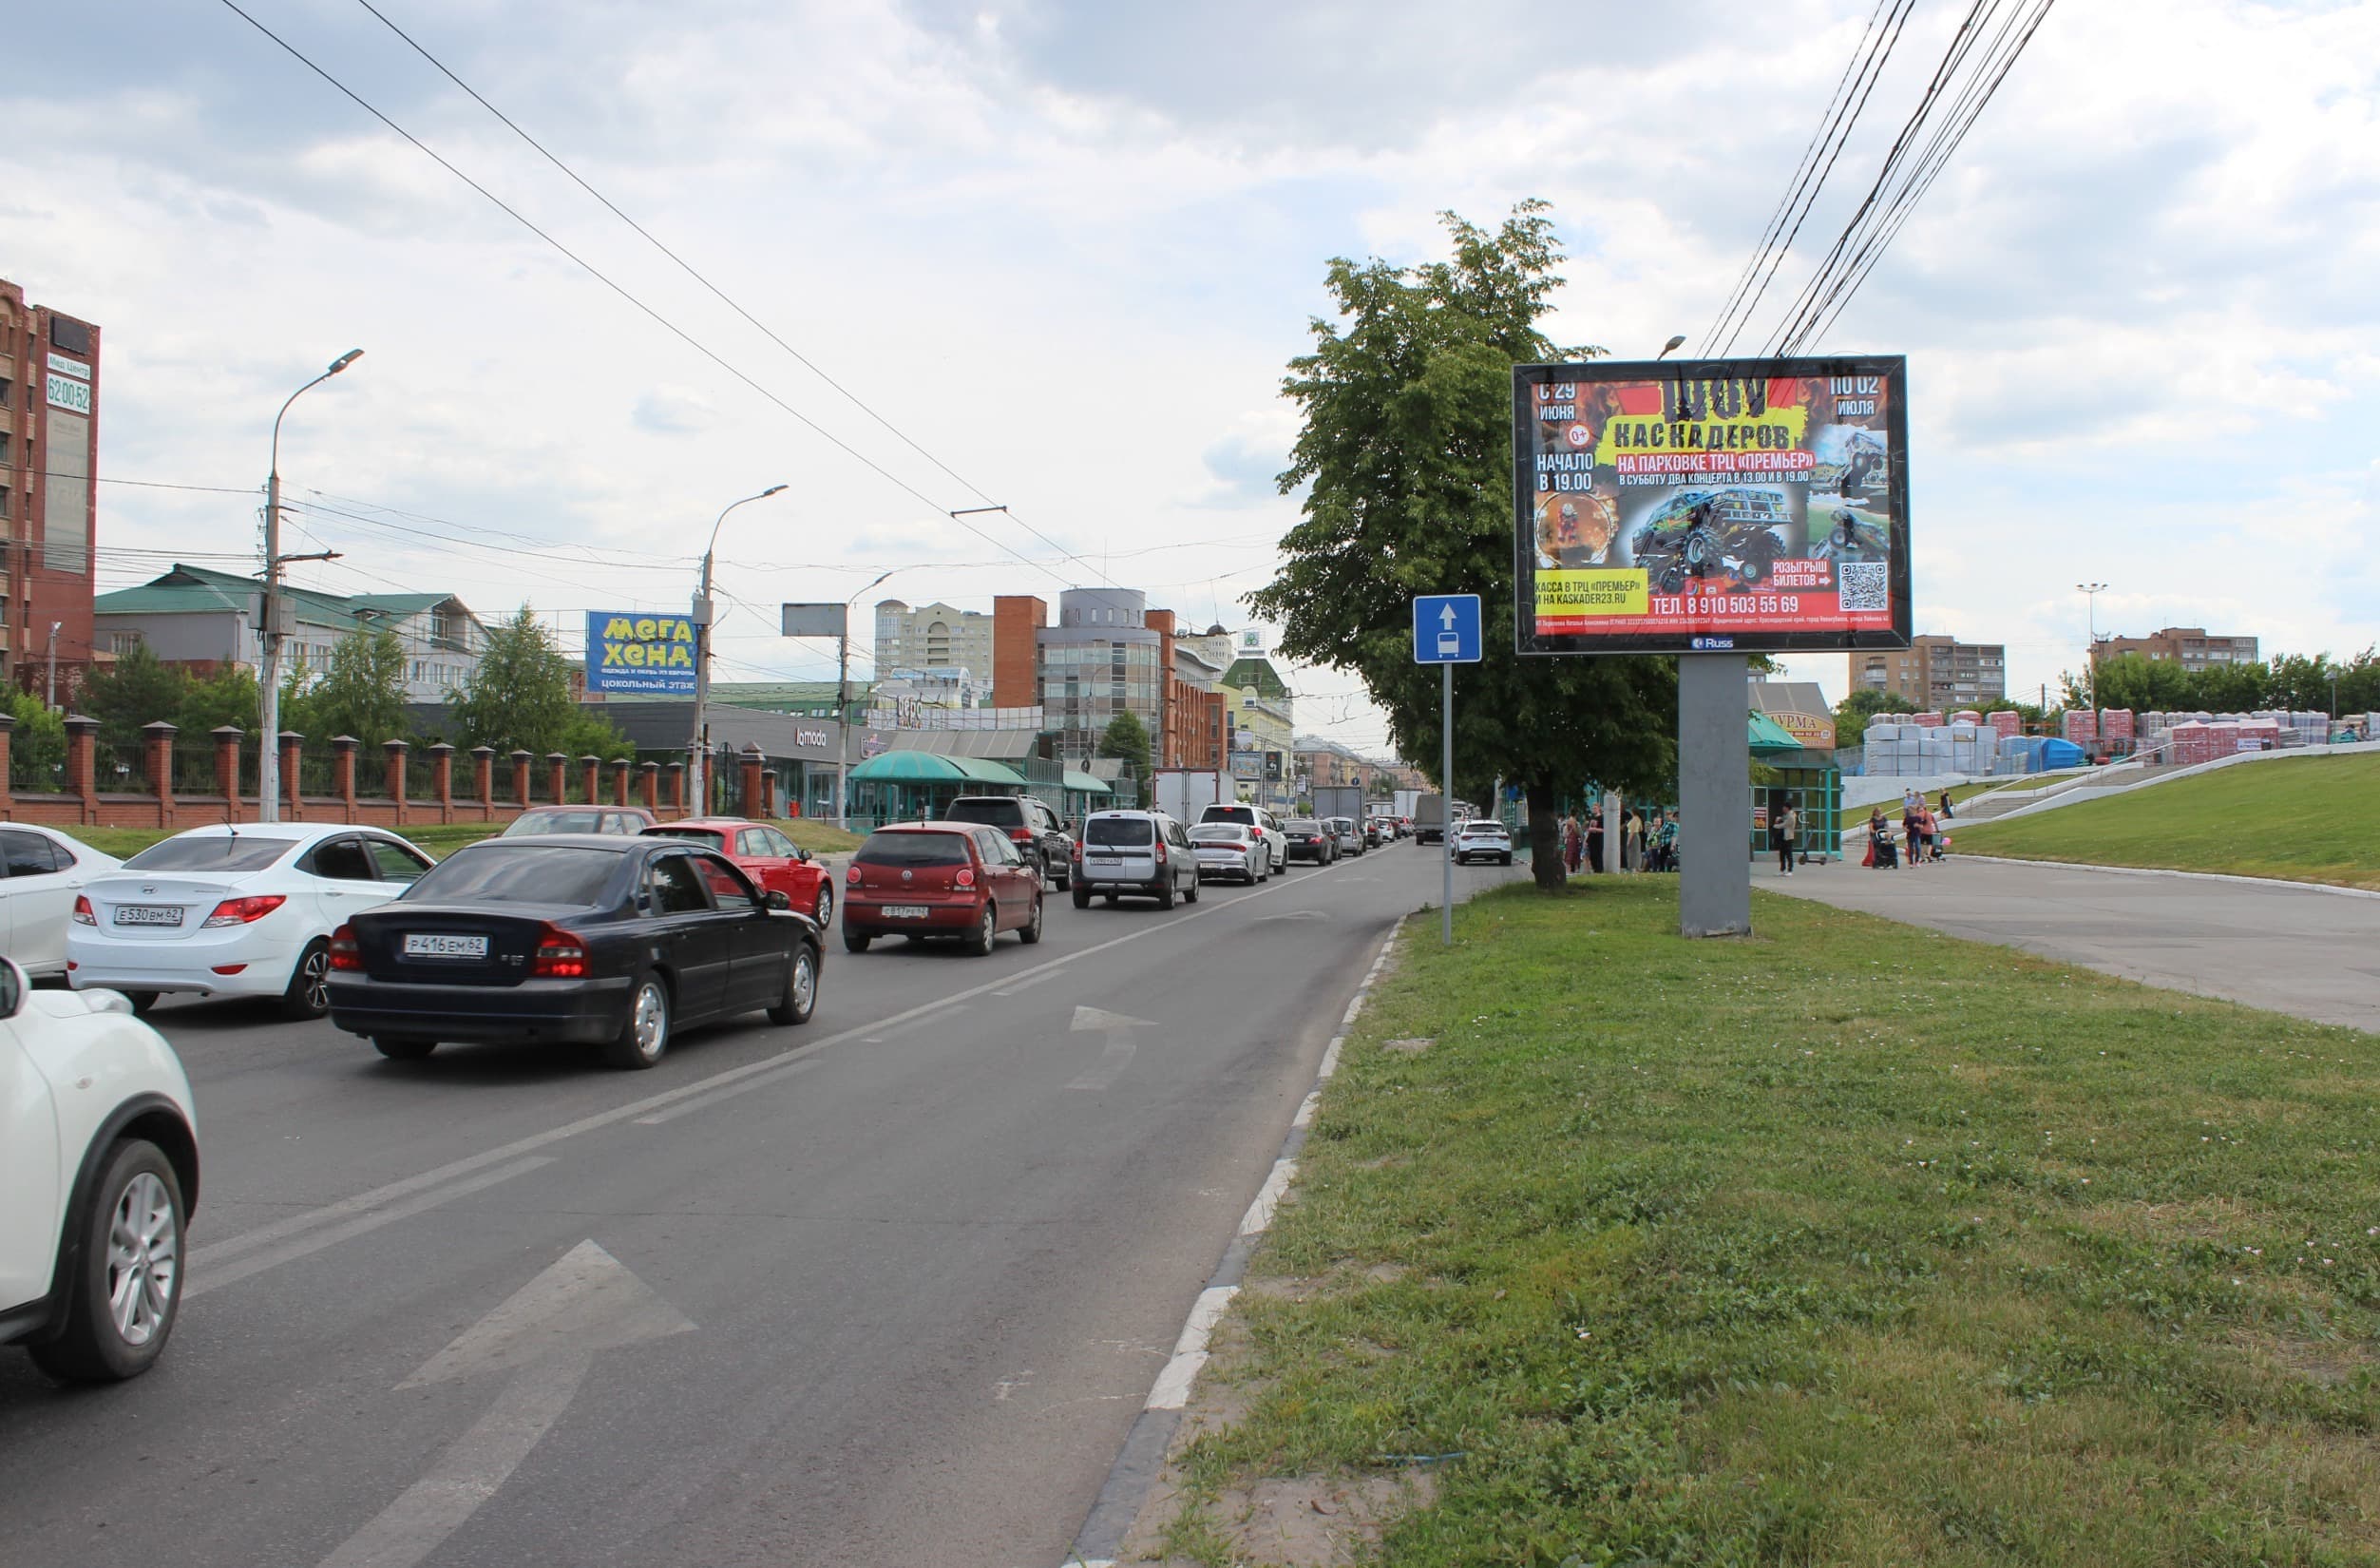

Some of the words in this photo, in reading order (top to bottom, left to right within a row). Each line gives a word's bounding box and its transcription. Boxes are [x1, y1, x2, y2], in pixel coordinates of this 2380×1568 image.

[1554, 382, 1576, 399] 29
[1856, 377, 1878, 394] 02
[1540, 405, 1574, 420] ИЮНЯ
[1837, 400, 1875, 415] ИЮЛЯ
[1571, 430, 1588, 441] 0+
[1615, 422, 1790, 450] КАСКАДЕРОВ
[1537, 453, 1593, 471] НАЧАЛО
[1618, 456, 1635, 472] НА
[1639, 454, 1706, 471] ПАРКОВКЕ
[1710, 454, 1736, 471] ТРЦ
[1738, 452, 1814, 470] «ПРЕМЬЕР»
[1539, 474, 1549, 491] В
[1553, 473, 1592, 490] 19.00
[1619, 475, 1626, 486] В
[1628, 474, 1666, 486] СУББОТУ
[1667, 474, 1686, 486] ДВА
[1688, 473, 1732, 486] КОНЦЕРТА
[1734, 472, 1741, 484] В
[1742, 472, 1766, 484] 13.00
[1768, 472, 1775, 483] И
[1776, 471, 1782, 483] В
[1785, 471, 1809, 483] 19.00
[1773, 561, 1828, 574] РОЗЫГРЫШ
[1534, 582, 1563, 592] КАССА
[1565, 582, 1571, 591] В
[1573, 582, 1590, 593] ТРЦ
[1590, 581, 1641, 592] «ПРЕМЬЕР»
[1773, 574, 1817, 586] БИЛЕТОВ
[1544, 594, 1554, 604] НА
[1556, 593, 1627, 604] KASKADER23.RU
[1653, 598, 1684, 615] ТЕЛ.
[1687, 598, 1696, 614] 8
[1700, 597, 1726, 614] 910
[1730, 597, 1756, 614] 503
[1760, 596, 1778, 613] 55
[1780, 596, 1799, 613] 69
[1705, 638, 1734, 648] Russ
[795, 727, 827, 747] lamoda
